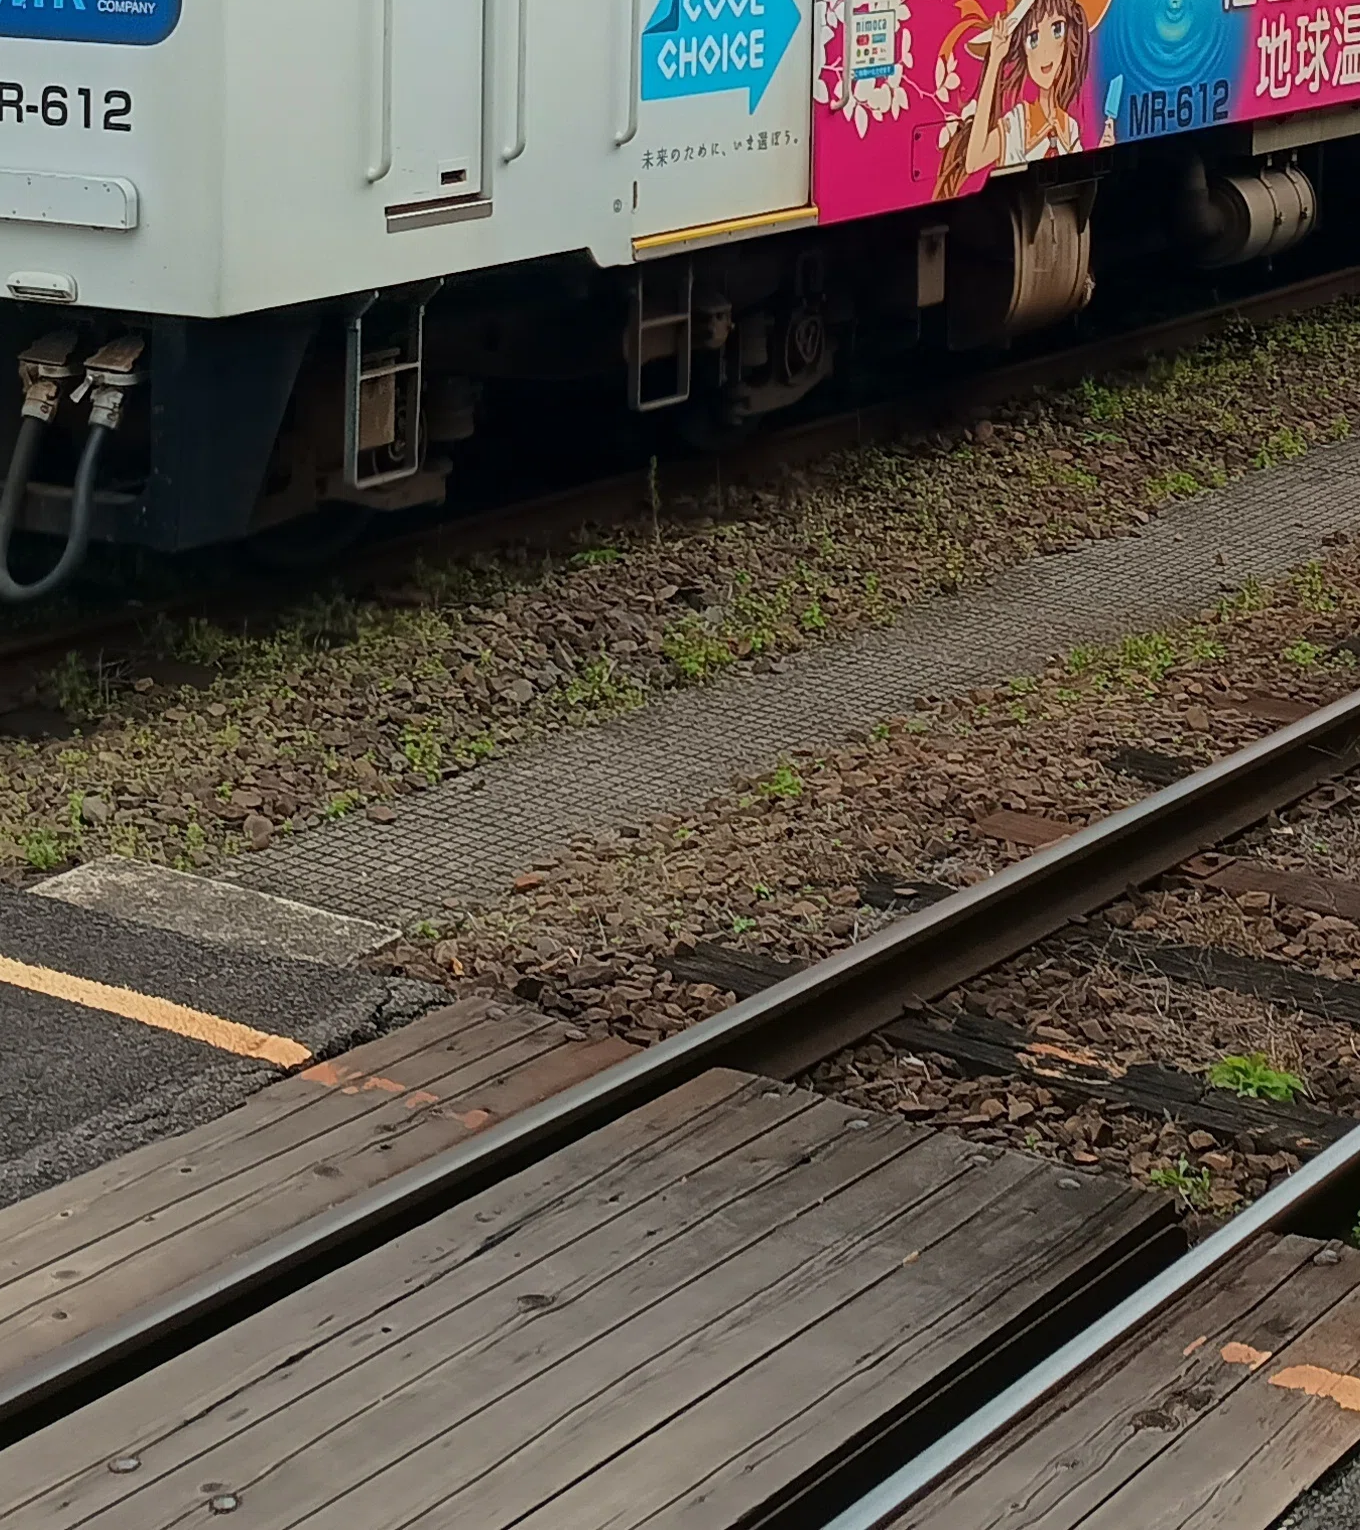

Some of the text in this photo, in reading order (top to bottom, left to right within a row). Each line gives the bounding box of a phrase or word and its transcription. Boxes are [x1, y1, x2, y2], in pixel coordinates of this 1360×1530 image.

[97, 0, 157, 14] COMPANY
[657, 28, 765, 80] CHOICE
[1130, 78, 1229, 138] MR-612
